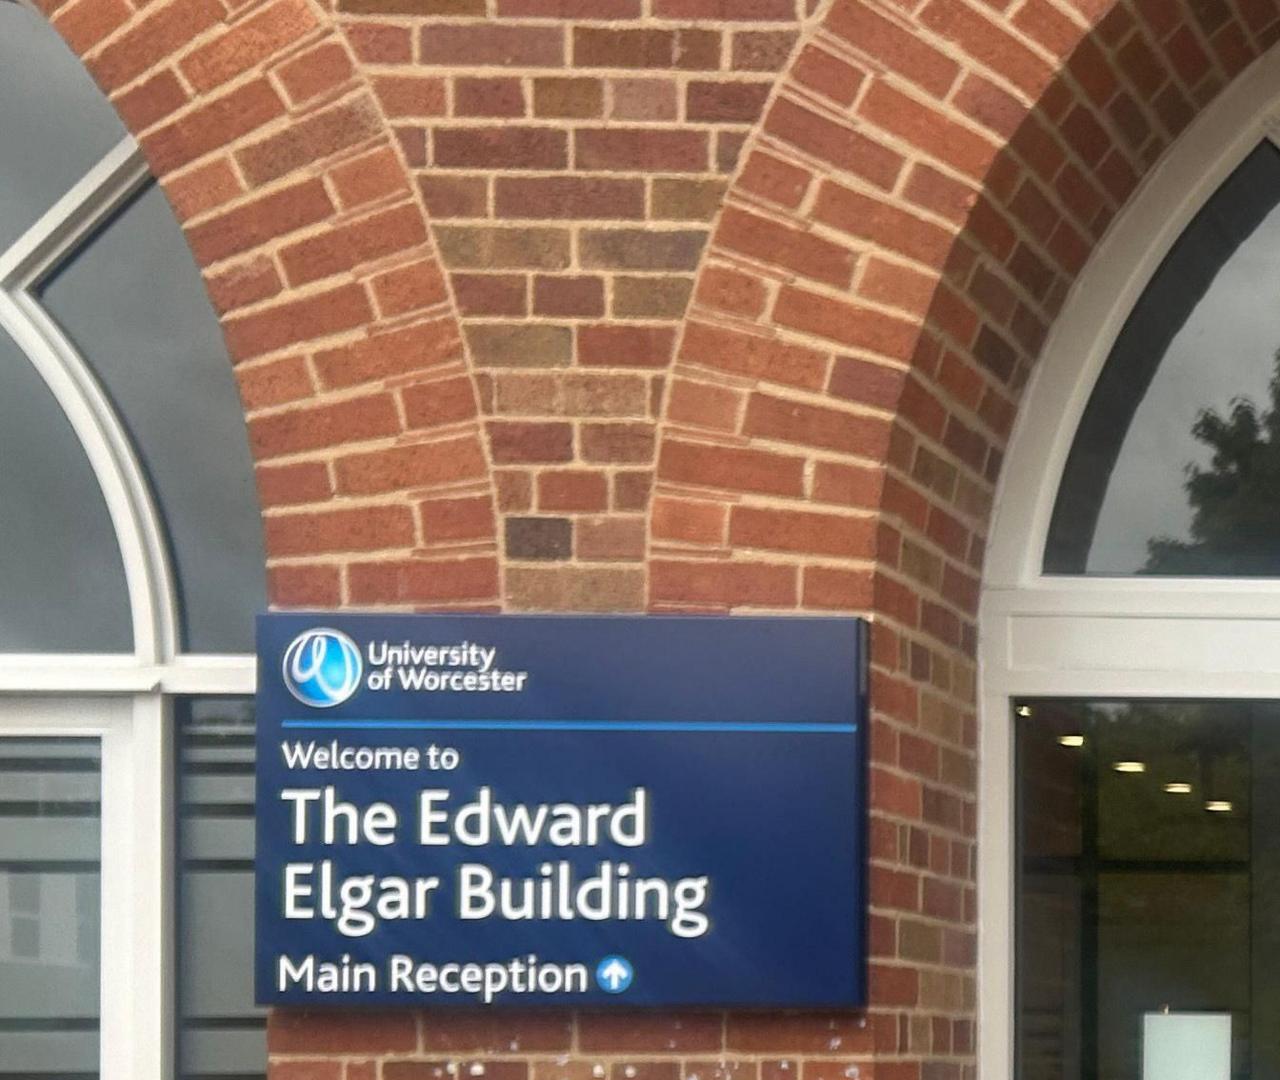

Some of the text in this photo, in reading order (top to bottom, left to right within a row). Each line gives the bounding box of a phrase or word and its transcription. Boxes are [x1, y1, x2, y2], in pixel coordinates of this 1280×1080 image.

[368, 640, 496, 671] University
[367, 667, 527, 691] of Worcester
[282, 740, 459, 770] Welcome to
[281, 786, 645, 846] The Edward
[285, 860, 708, 937] Elgar Building
[280, 954, 587, 1003] Main Reception
